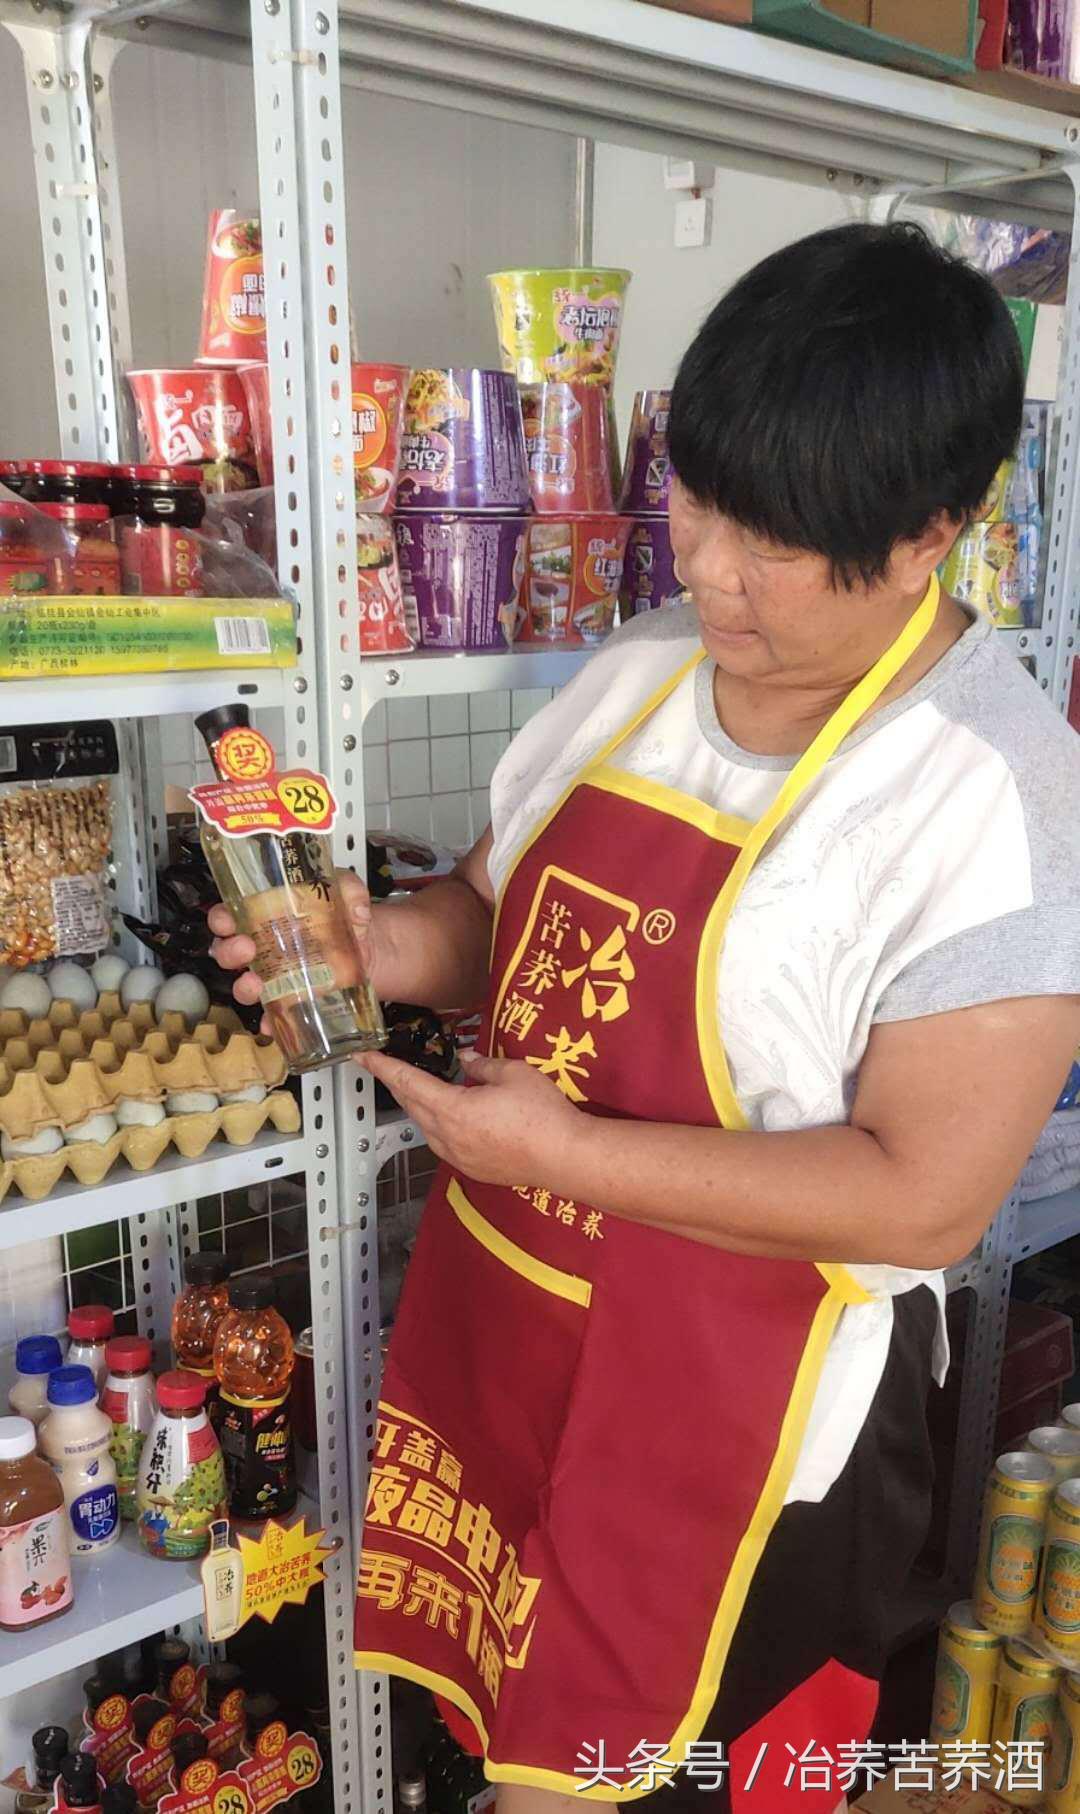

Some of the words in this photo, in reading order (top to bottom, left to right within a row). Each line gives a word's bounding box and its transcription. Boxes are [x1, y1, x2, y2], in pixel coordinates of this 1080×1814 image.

[285, 785, 325, 813] 28
[497, 900, 573, 1042] 苦荞酒
[291, 1752, 314, 1781] 28
